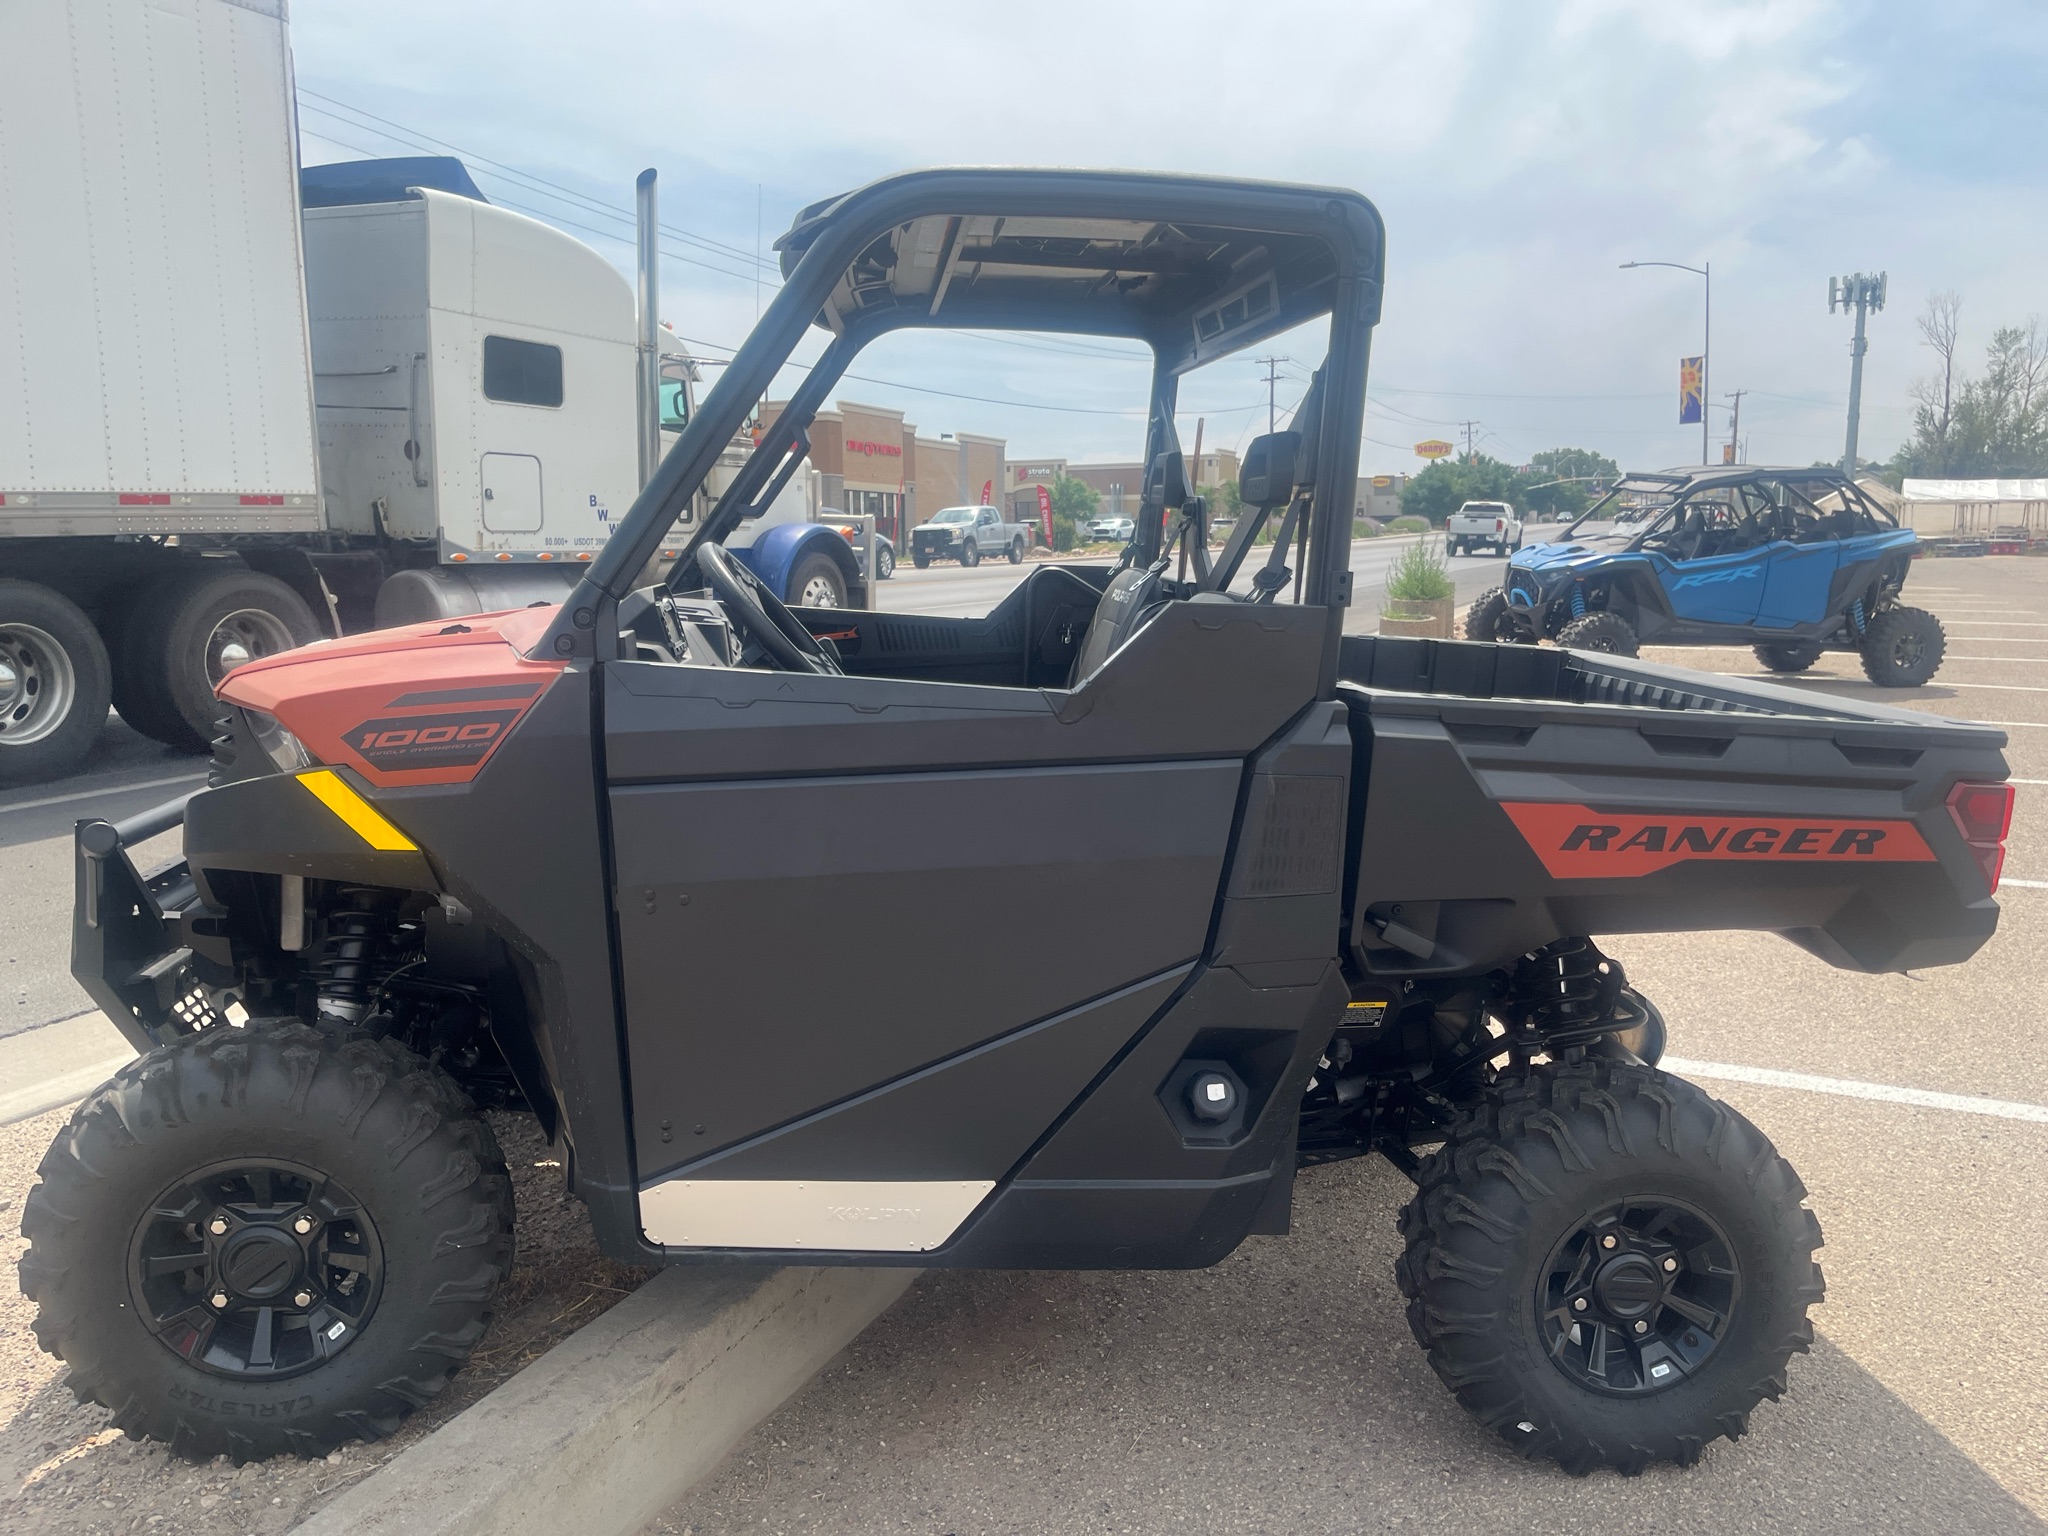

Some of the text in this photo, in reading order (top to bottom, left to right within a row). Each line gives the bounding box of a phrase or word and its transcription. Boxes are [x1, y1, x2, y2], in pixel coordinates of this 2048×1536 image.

[1417, 444, 1449, 454] Denny's
[589, 495, 597, 507] B
[598, 510, 608, 521] W
[574, 538, 594, 546] USDOT
[1671, 565, 1762, 592] RZR
[360, 723, 500, 749] 1000
[368, 741, 492, 757] SINGLE OVERHEAD CAM
[1558, 824, 1887, 855] RANGER
[826, 1205, 921, 1223] KOLPIN
[167, 1382, 315, 1418] CARLSTAR
